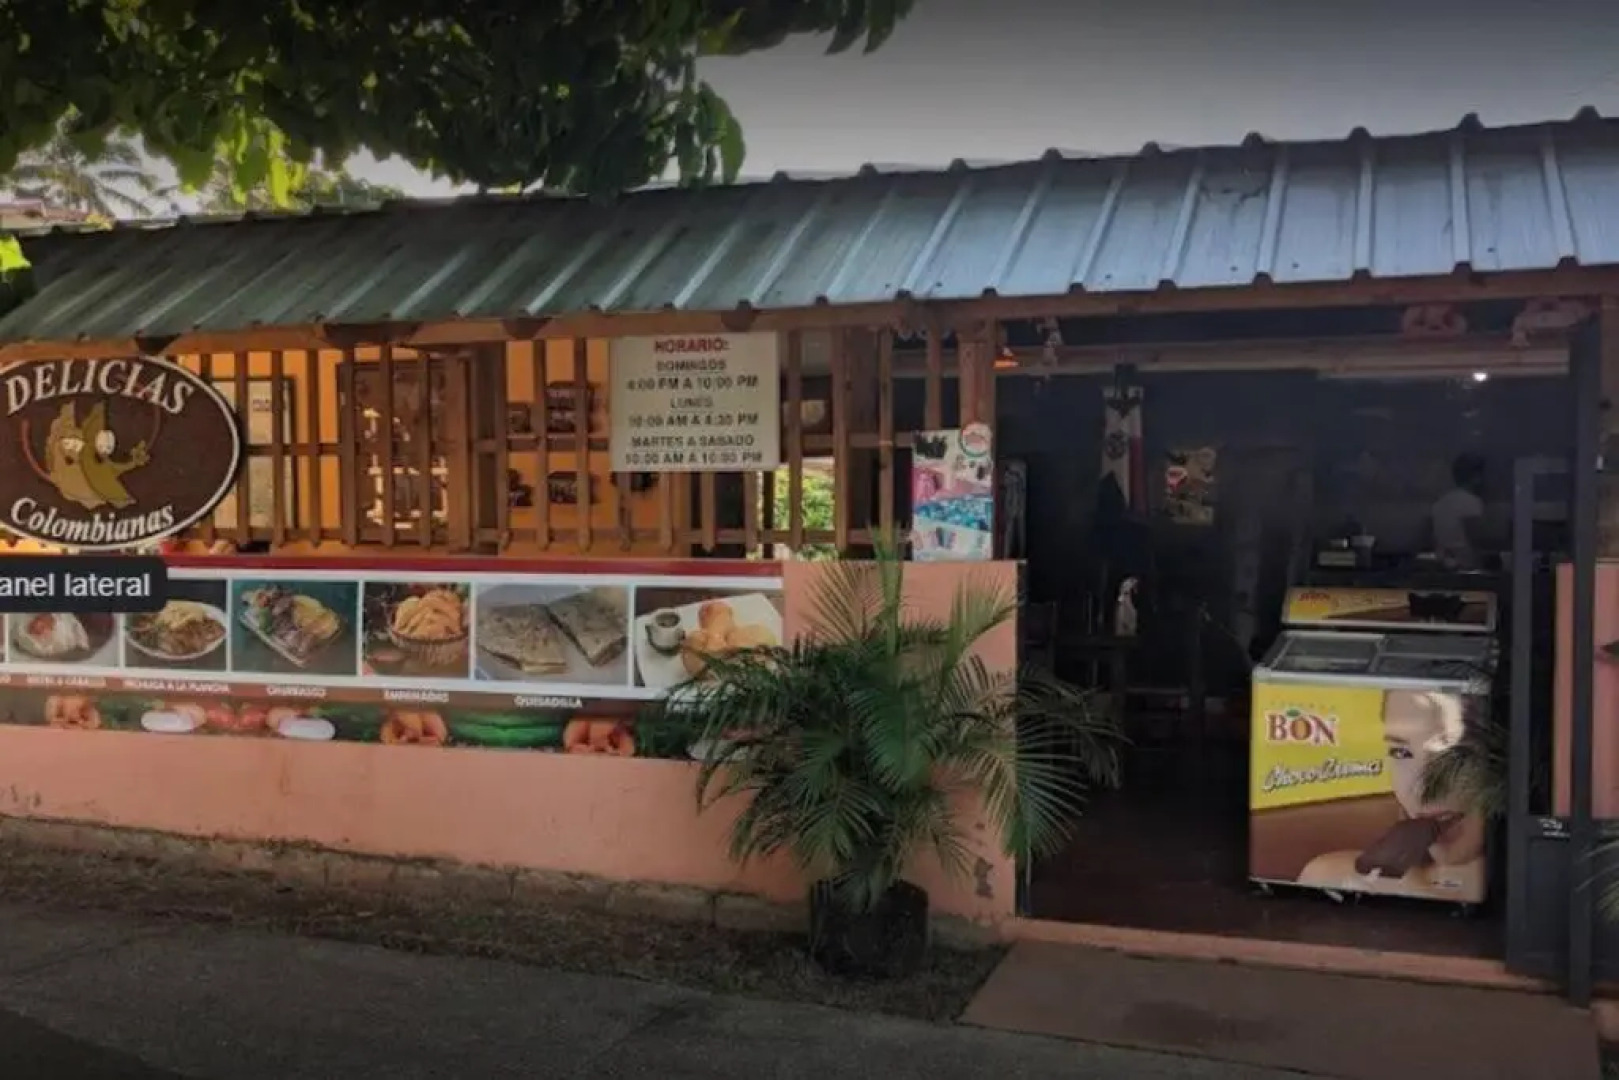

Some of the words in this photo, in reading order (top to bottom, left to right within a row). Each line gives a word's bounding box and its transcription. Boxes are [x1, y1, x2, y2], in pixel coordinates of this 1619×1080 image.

[655, 337, 730, 353] HORARIO:
[656, 358, 727, 371] DOMINGOS
[5, 359, 195, 417] DELICIAS
[658, 377, 679, 390] PM
[682, 377, 692, 390] A
[736, 374, 759, 388] PM
[670, 396, 713, 409] LUNES
[666, 414, 688, 426] AM
[691, 414, 701, 425] A
[737, 412, 759, 425] PM
[631, 435, 683, 447] MARTES
[687, 435, 697, 447] A
[663, 452, 684, 464] AM
[688, 451, 698, 463] A
[742, 450, 763, 463] PM
[10, 496, 175, 544] Colombianas
[1267, 711, 1337, 745] BON
